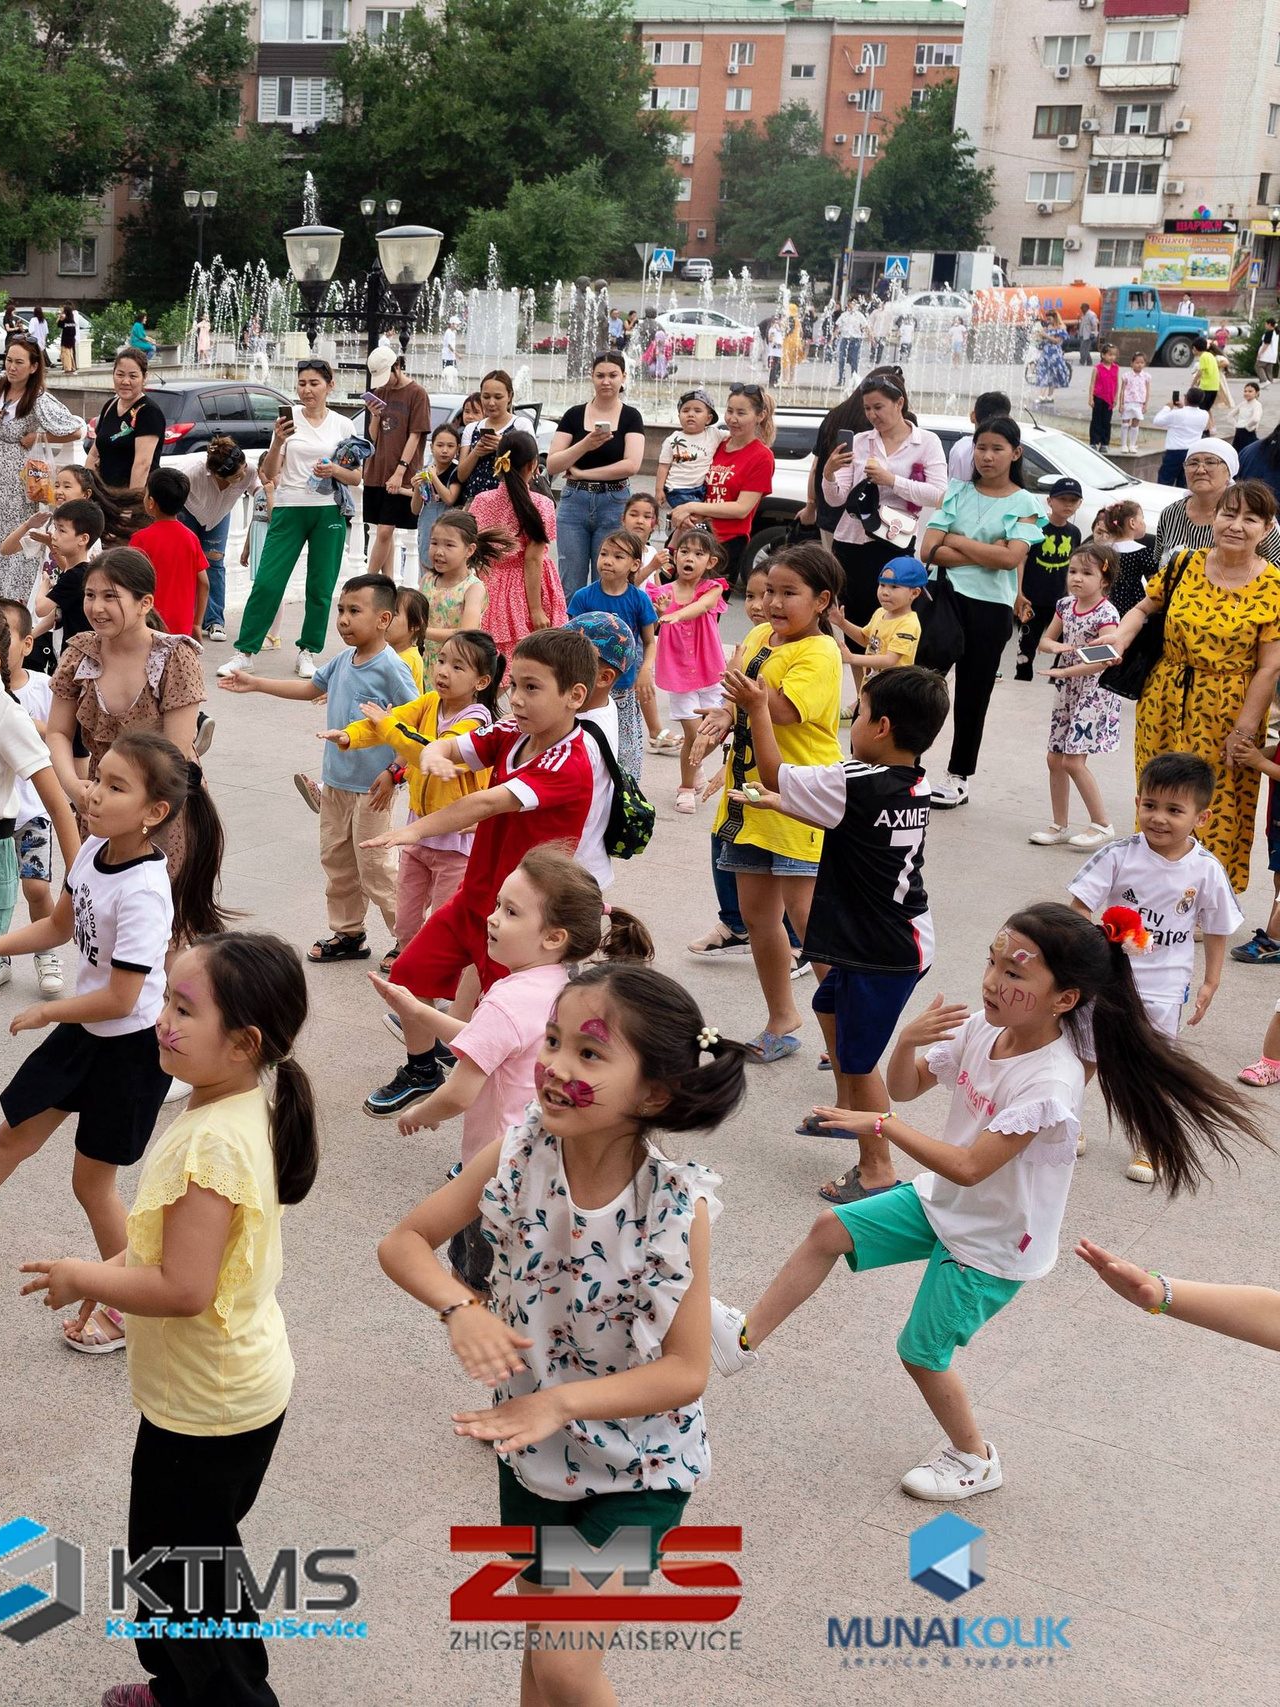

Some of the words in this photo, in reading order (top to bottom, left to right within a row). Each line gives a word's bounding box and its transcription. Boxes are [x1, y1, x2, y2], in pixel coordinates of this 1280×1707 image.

[1176, 221, 1223, 232] ШАРИКИ
[889, 828, 923, 905] 7
[1138, 907, 1165, 927] Fly
